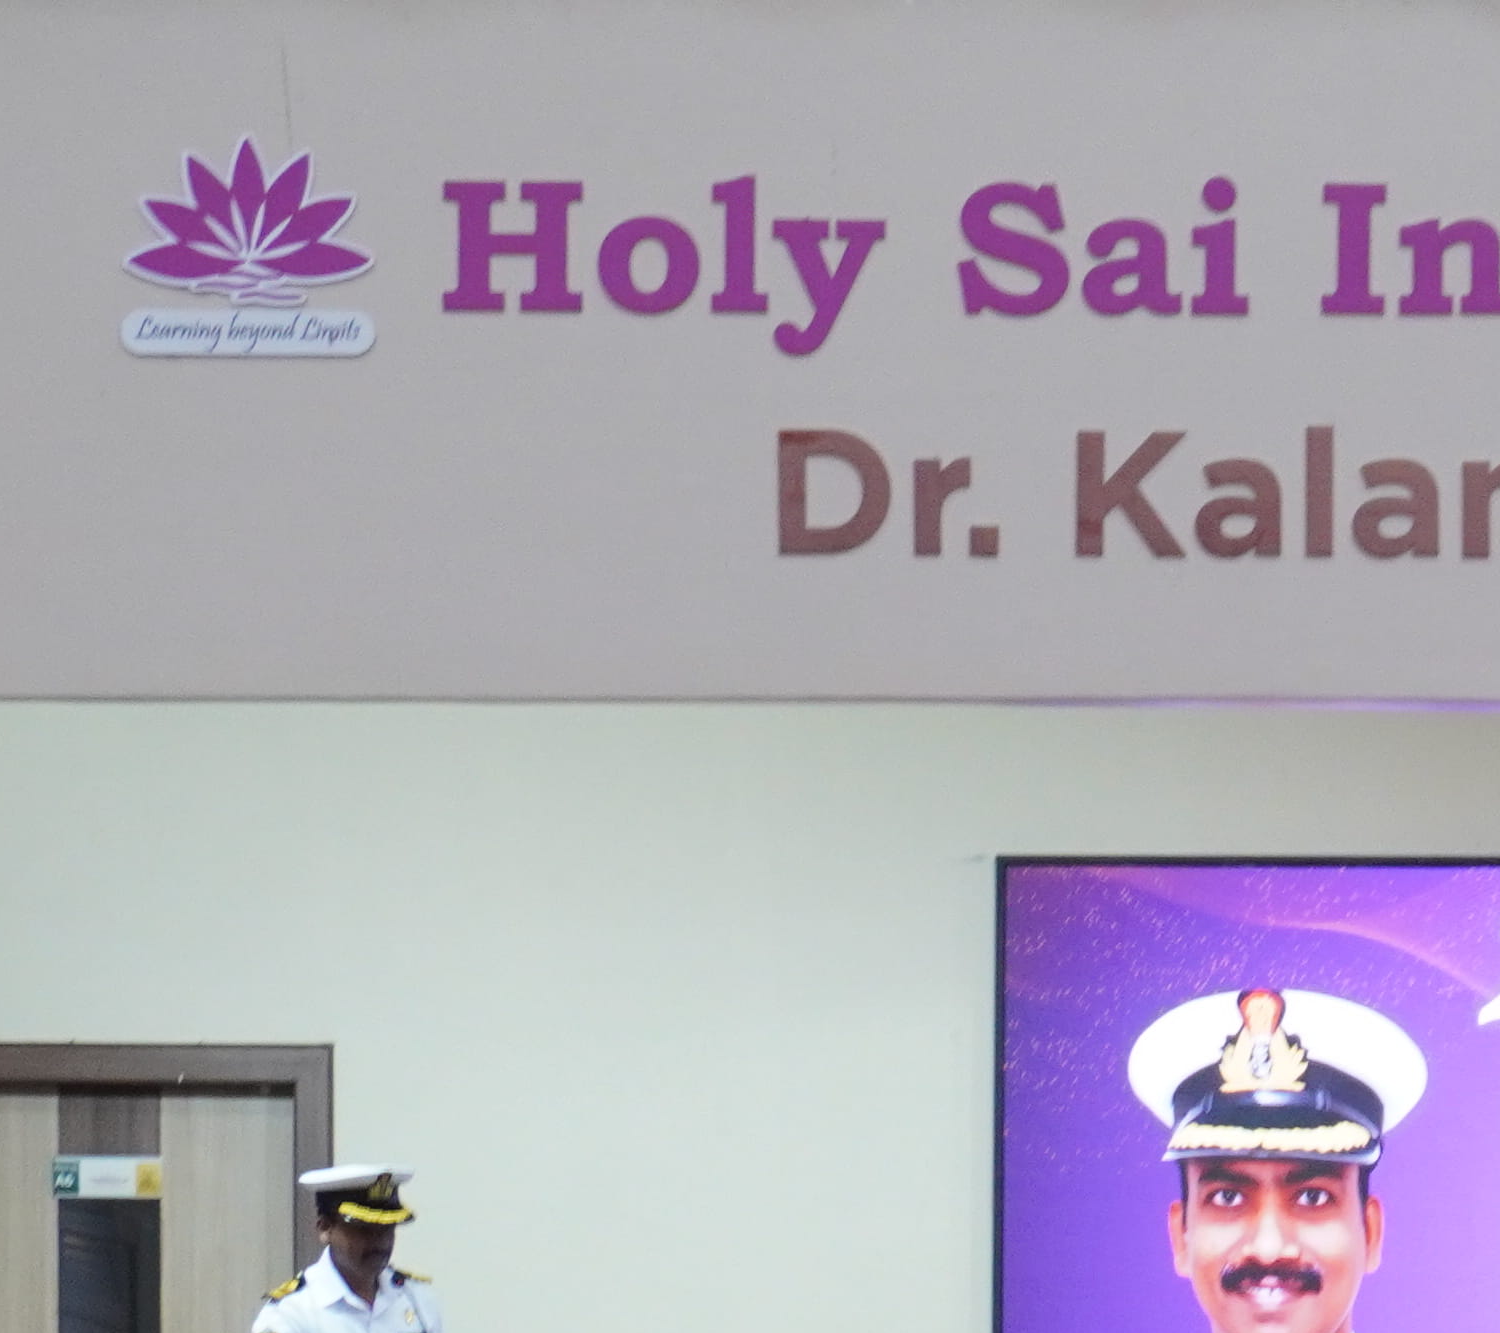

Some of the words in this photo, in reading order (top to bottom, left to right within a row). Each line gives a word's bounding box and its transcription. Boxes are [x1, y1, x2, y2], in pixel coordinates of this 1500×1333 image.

[135, 316, 222, 353] Learning
[228, 311, 301, 353] beyond
[441, 174, 888, 357] Holy
[956, 175, 1251, 317] Sai
[774, 426, 1003, 559] Dr.
